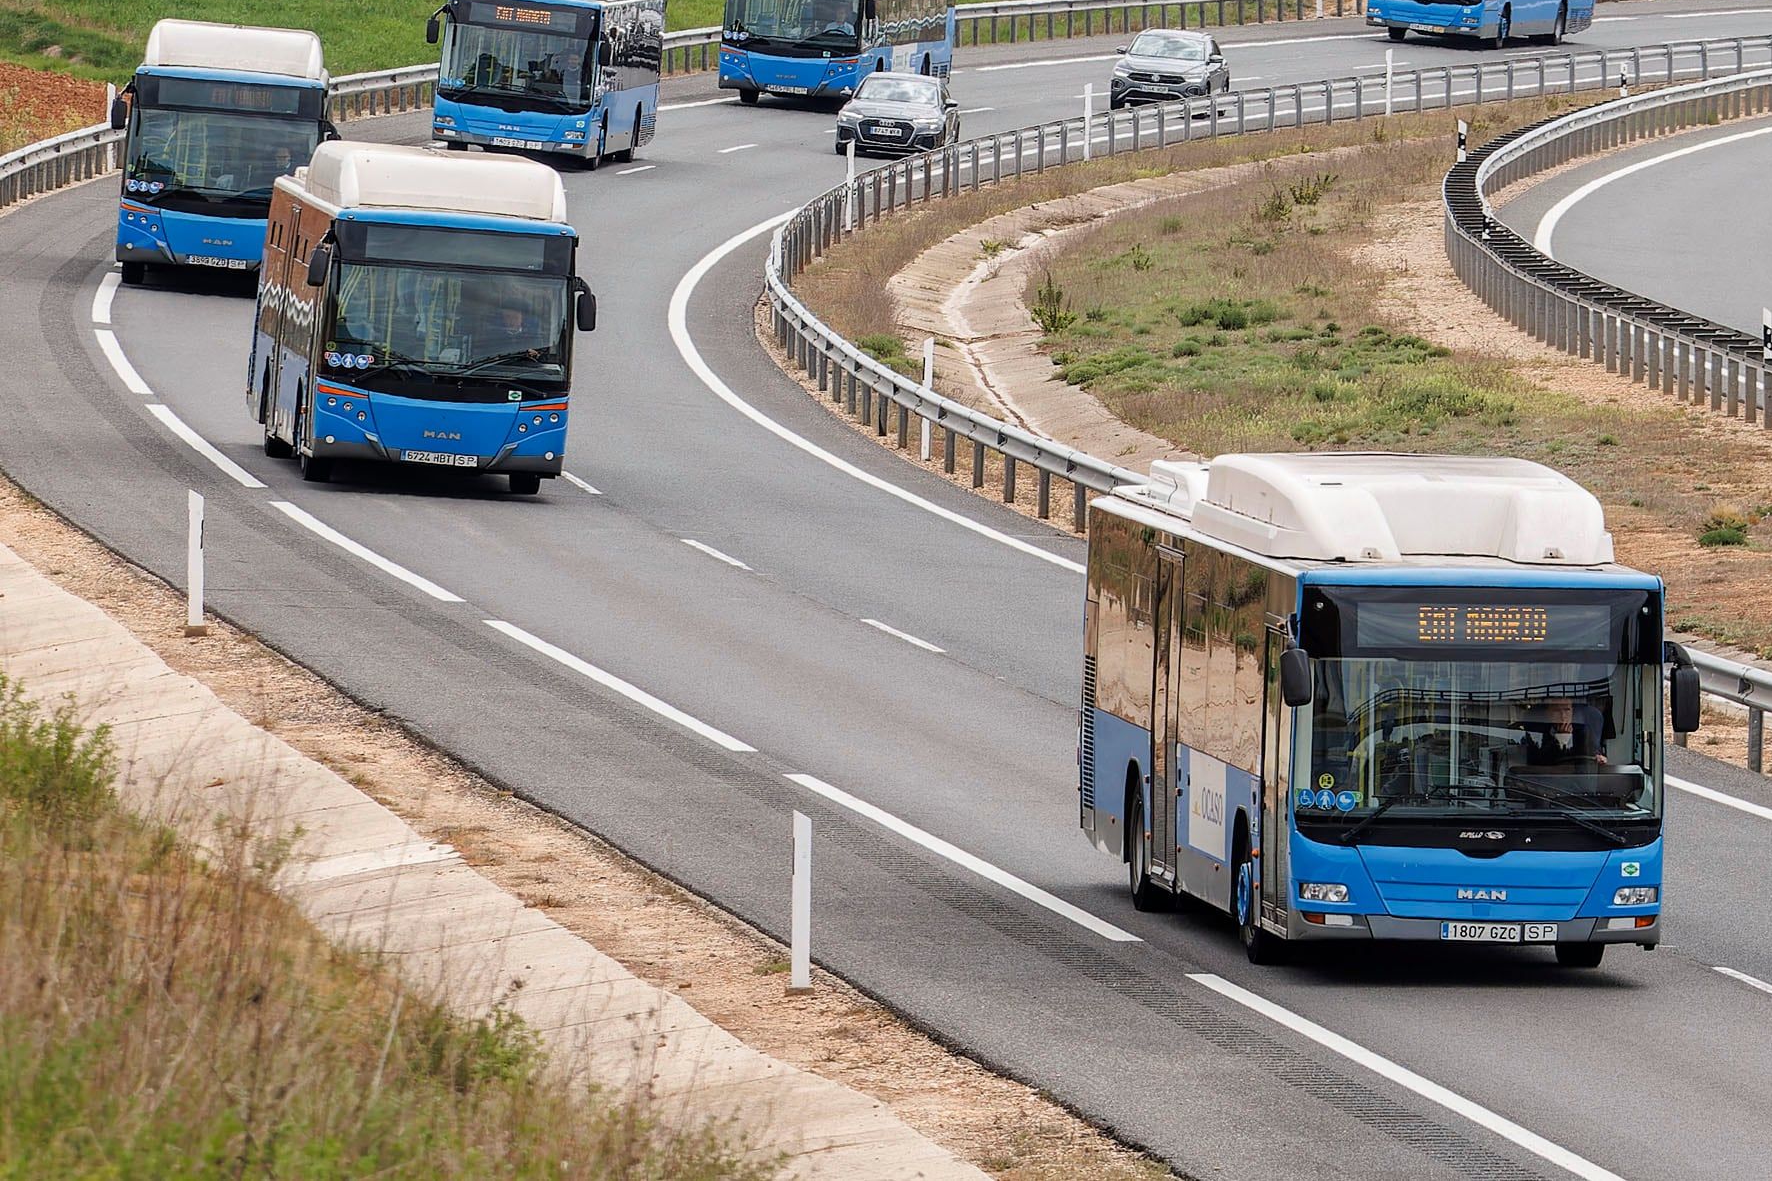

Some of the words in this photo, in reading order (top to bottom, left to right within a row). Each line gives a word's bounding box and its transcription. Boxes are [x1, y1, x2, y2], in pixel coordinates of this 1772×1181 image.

[423, 430, 461, 440] MAN
[407, 451, 431, 462] 6724
[433, 453, 453, 464] HBT
[457, 456, 474, 466] SP
[1419, 607, 1458, 640] EMT
[1466, 607, 1547, 641] MADRID
[1201, 786, 1223, 827] OCASO
[1457, 889, 1507, 901] MAN
[1453, 924, 1485, 938] 1807
[1490, 926, 1517, 940] GZC
[1528, 926, 1554, 939] SP
